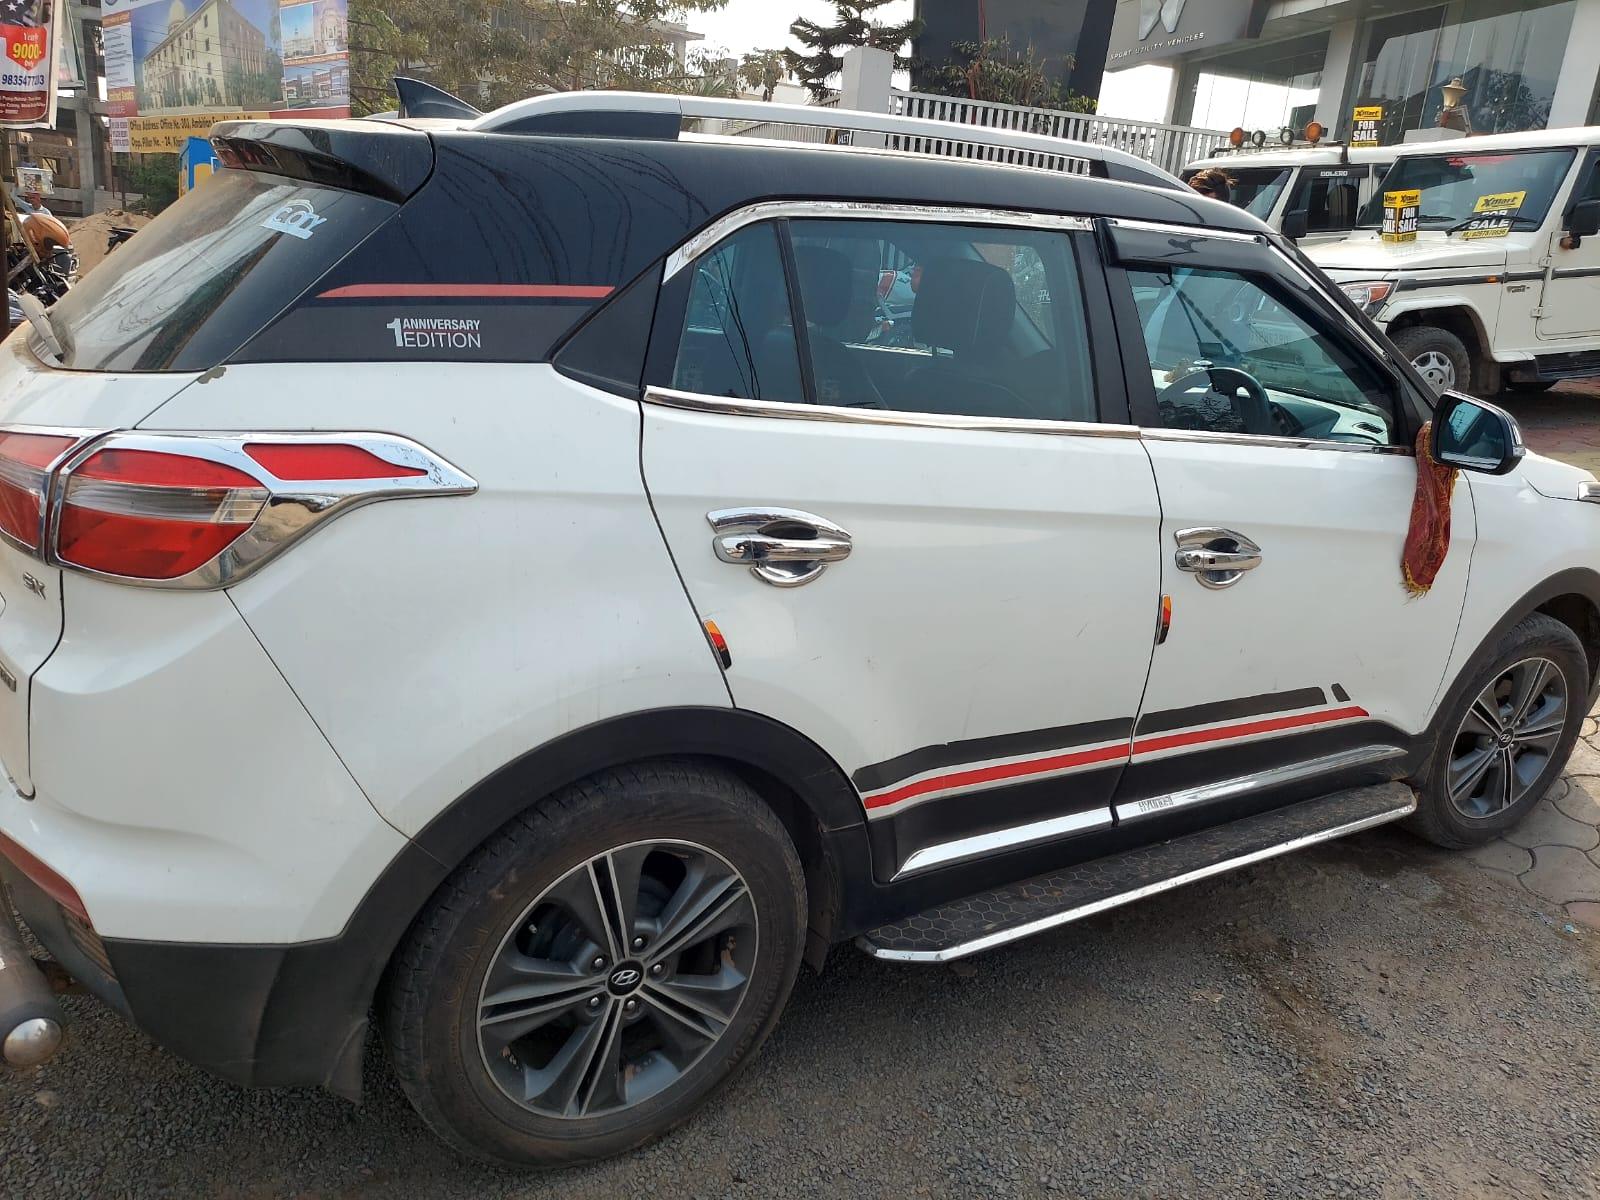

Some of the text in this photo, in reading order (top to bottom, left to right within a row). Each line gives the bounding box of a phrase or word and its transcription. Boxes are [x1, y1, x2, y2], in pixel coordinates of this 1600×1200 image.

[1110, 32, 1205, 60] SPORT UTILITY VEHICLES
[1356, 109, 1379, 117] Xmart
[1358, 120, 1375, 130] FOR
[1353, 130, 1378, 141] SALE
[1481, 196, 1518, 207] Xmart
[1402, 207, 1416, 219] FOR
[1382, 219, 1396, 233] SALE
[1398, 218, 1418, 233] SALE
[1468, 219, 1510, 230] SALE
[386, 317, 480, 347] 1 ANNIVERSARY
[404, 331, 481, 348] EDITION
